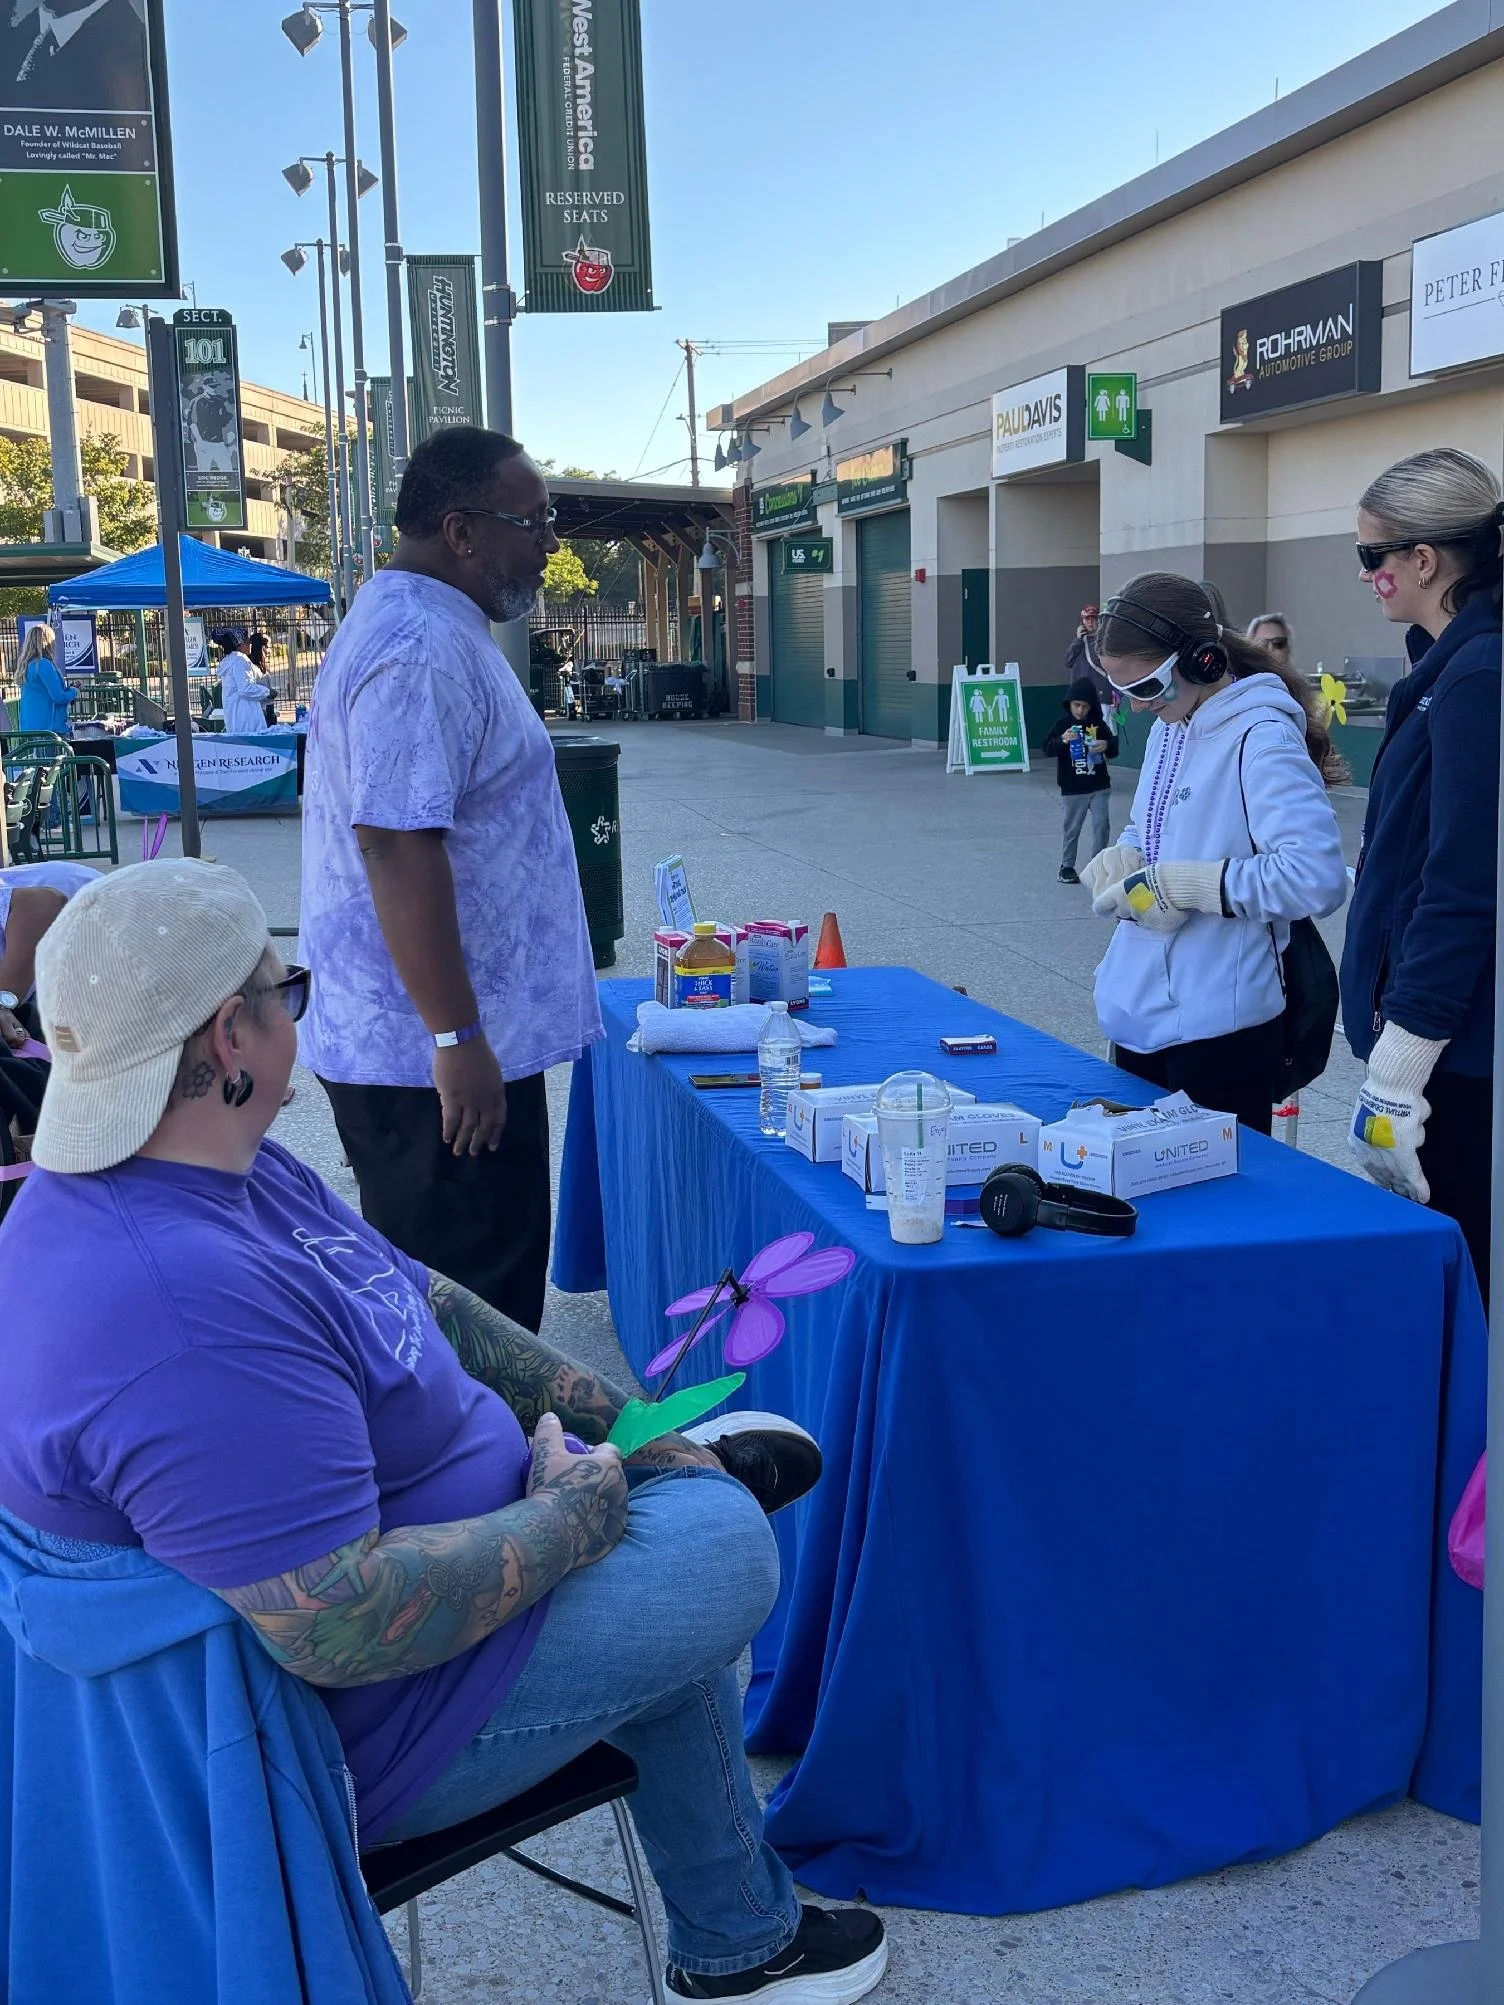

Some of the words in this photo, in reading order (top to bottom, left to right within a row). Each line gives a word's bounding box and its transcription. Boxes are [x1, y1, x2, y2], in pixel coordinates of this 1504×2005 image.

[573, 0, 592, 56] West
[563, 57, 571, 99] FEDERAL
[565, 101, 574, 136] CREDIT
[575, 58, 597, 170] America
[3, 124, 41, 137] DALE
[44, 125, 62, 137] W.
[65, 126, 136, 139] McMILLEN
[20, 140, 51, 148] Founder
[53, 140, 60, 148] of
[62, 141, 90, 149] Wildcat
[26, 151, 57, 160] Lovingly
[58, 152, 81, 160] called
[567, 139, 575, 170] UNION
[545, 191, 625, 205] RESERVED
[563, 209, 608, 223] SEATS
[1424, 267, 1482, 306] PETER
[183, 310, 222, 322] SECT.
[433, 276, 460, 395] HUNTINGTON
[1256, 302, 1353, 369] ROHRMAN
[185, 338, 226, 363] 101
[1259, 350, 1316, 379] AUTOMOTIVE
[1320, 340, 1352, 362] GROUP
[433, 406, 464, 414] PICNIC
[428, 416, 470, 424] PAVILION
[978, 726, 1008, 736] FAMILY
[972, 736, 1018, 747] RESTROOM
[219, 755, 280, 769] RESEARCH
[967, 1112, 1015, 1120] GLOVES
[1385, 1106, 1411, 1118] VIRTUAL
[1020, 1132, 1028, 1144] L
[1223, 1127, 1232, 1141] M
[1043, 1140, 1053, 1152] M
[1154, 1140, 1209, 1162] UNITED
